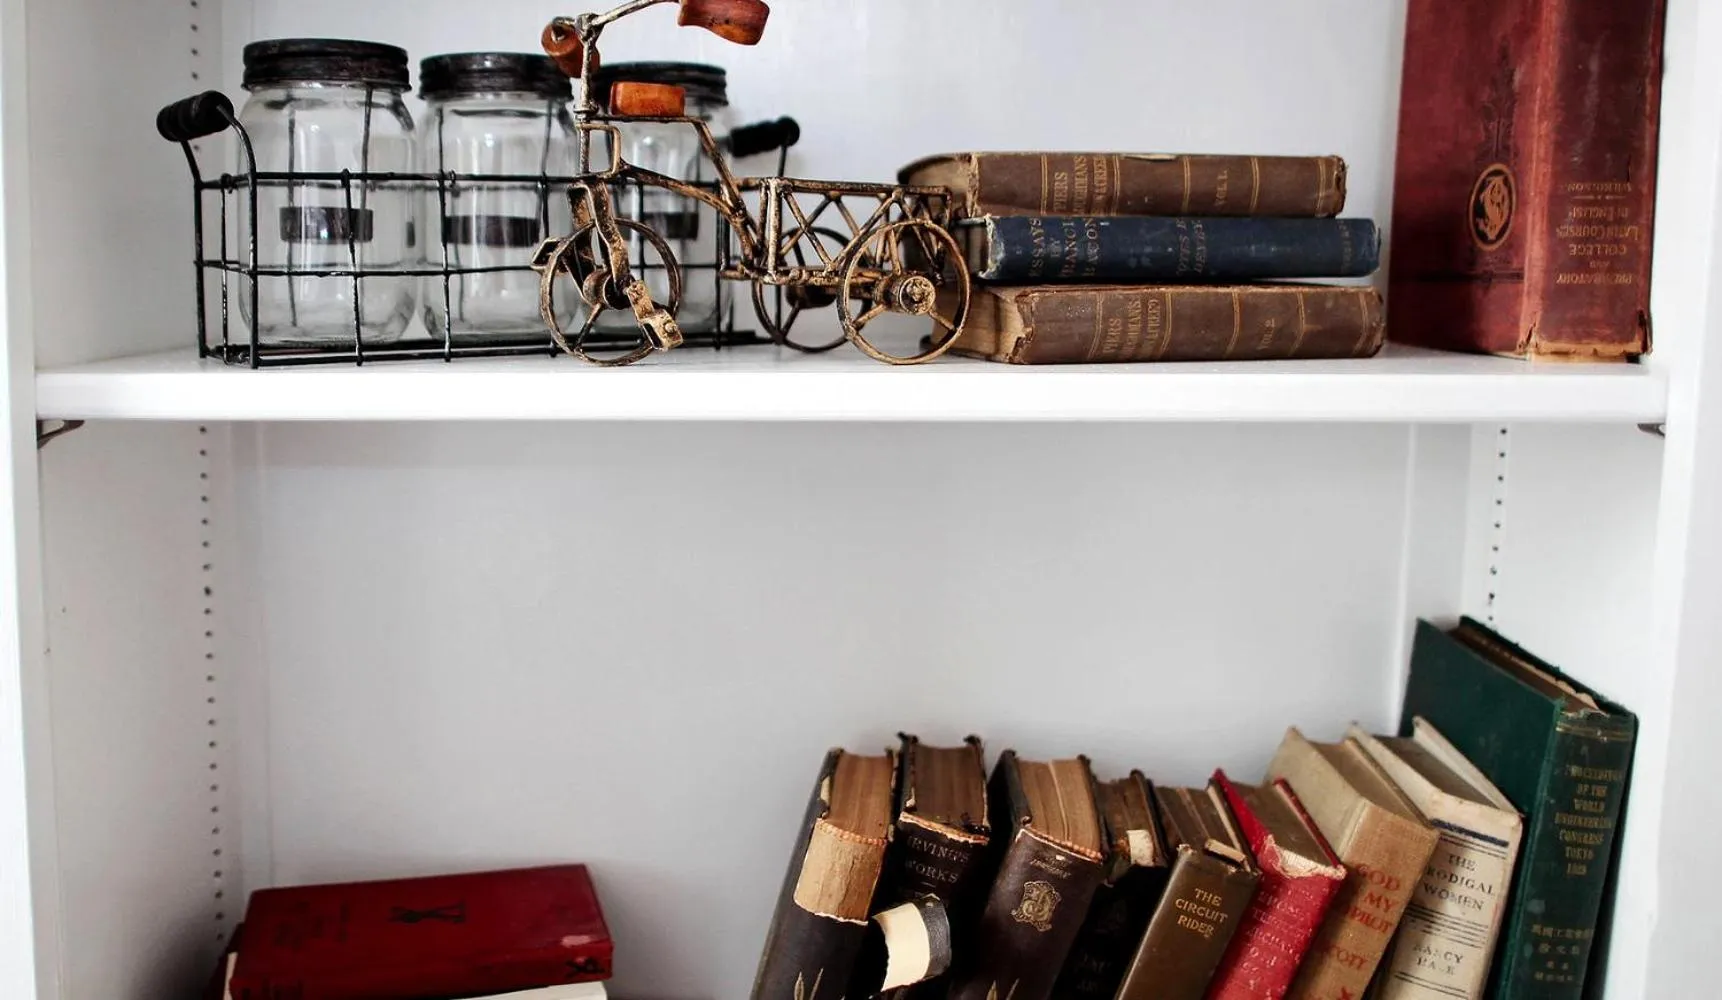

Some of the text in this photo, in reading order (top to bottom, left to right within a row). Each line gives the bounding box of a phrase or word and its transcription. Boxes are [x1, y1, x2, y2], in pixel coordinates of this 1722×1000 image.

[1053, 171, 1069, 213] PIERS
[1568, 242, 1628, 256] COLLEGE
[1102, 318, 1123, 354] PIERS
[905, 859, 959, 885] WORKS
[1448, 853, 1478, 872] THE
[1356, 863, 1401, 892] GOD
[1426, 865, 1495, 896] RODIGAL
[1194, 887, 1223, 907] THE
[1363, 892, 1394, 913] MY
[1423, 882, 1486, 912] WOMEN
[1175, 898, 1228, 924] CIRCUIT
[1177, 914, 1216, 937] RIDER
